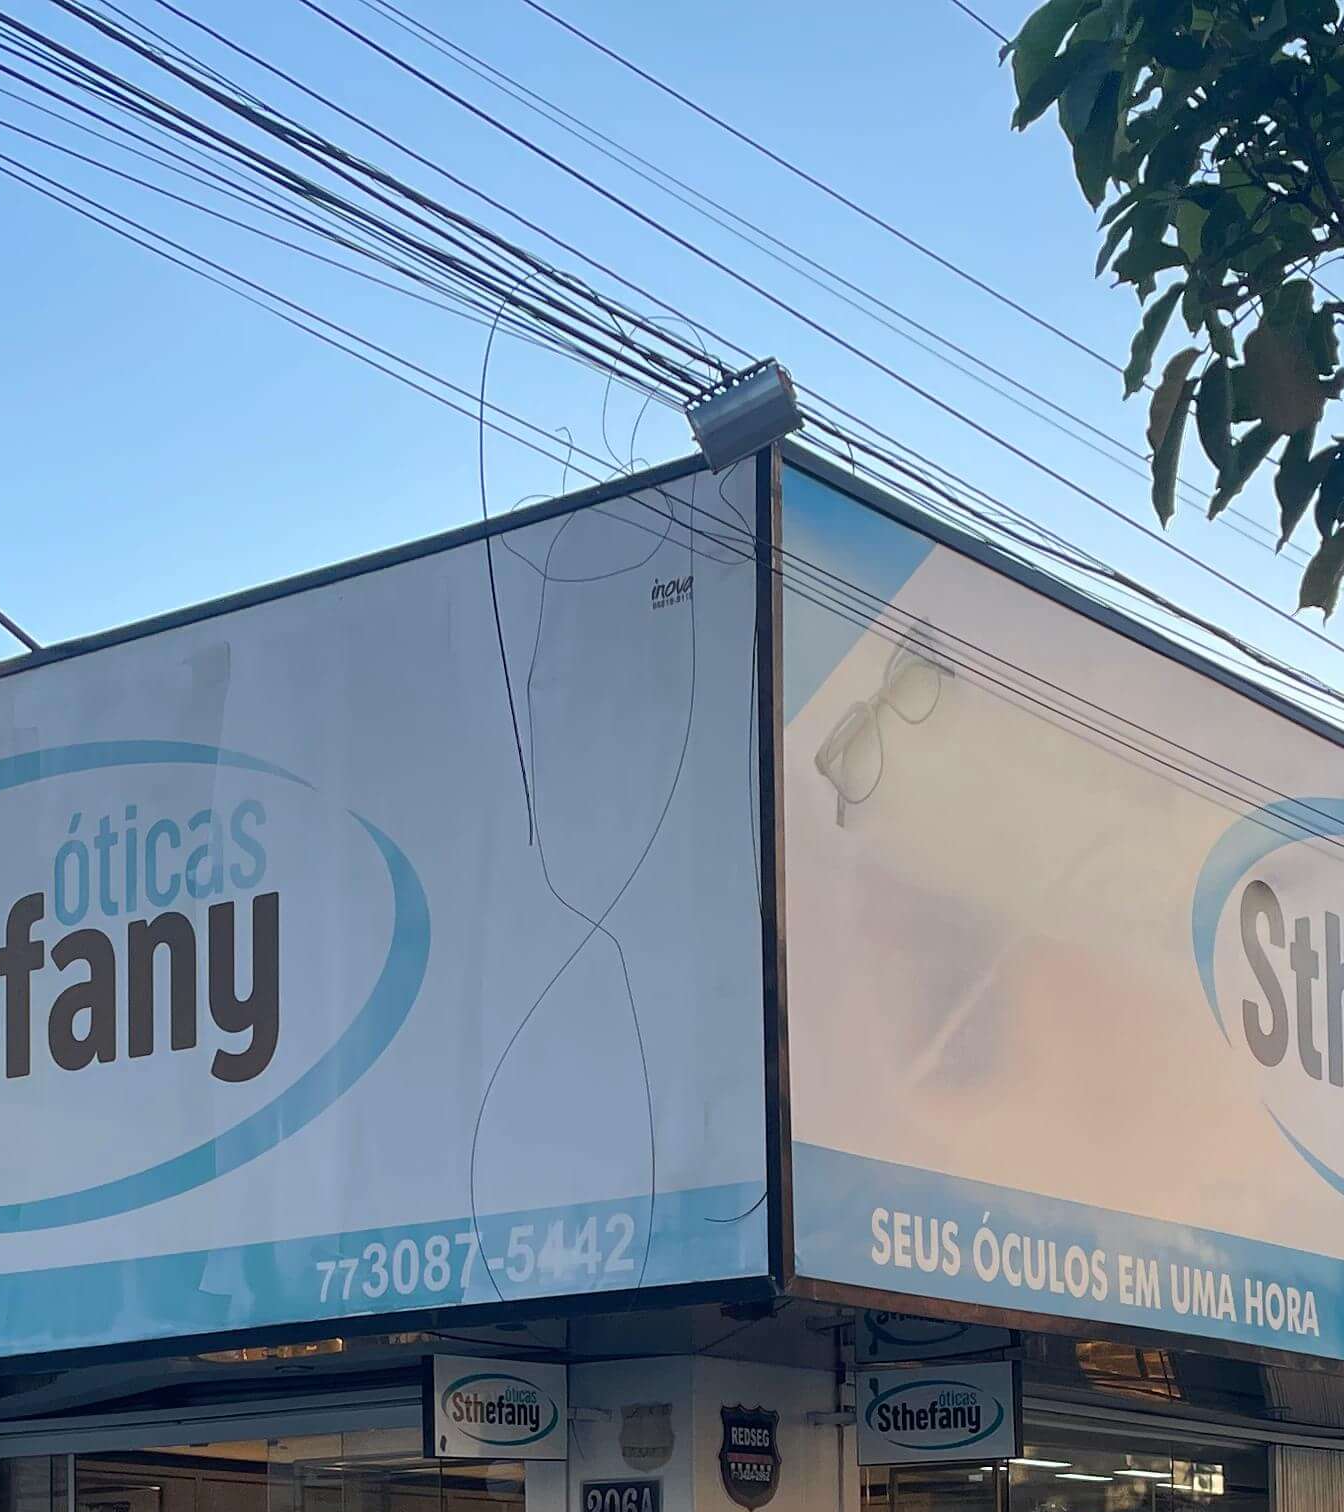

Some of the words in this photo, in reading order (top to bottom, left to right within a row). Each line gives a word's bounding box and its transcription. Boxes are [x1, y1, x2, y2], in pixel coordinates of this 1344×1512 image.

[652, 576, 694, 600] inova
[55, 797, 267, 927] óticas
[870, 1207, 961, 1277] SEUS
[972, 1211, 1107, 1302] ÓCULOS
[1119, 1254, 1162, 1310] EM
[1169, 1263, 1237, 1322] UMA
[1244, 1278, 1320, 1338] HORA
[452, 1392, 540, 1432] Sthefany
[938, 1390, 978, 1407] óticas
[877, 1400, 981, 1433] Sthefany
[731, 1426, 770, 1447] REDSEG
